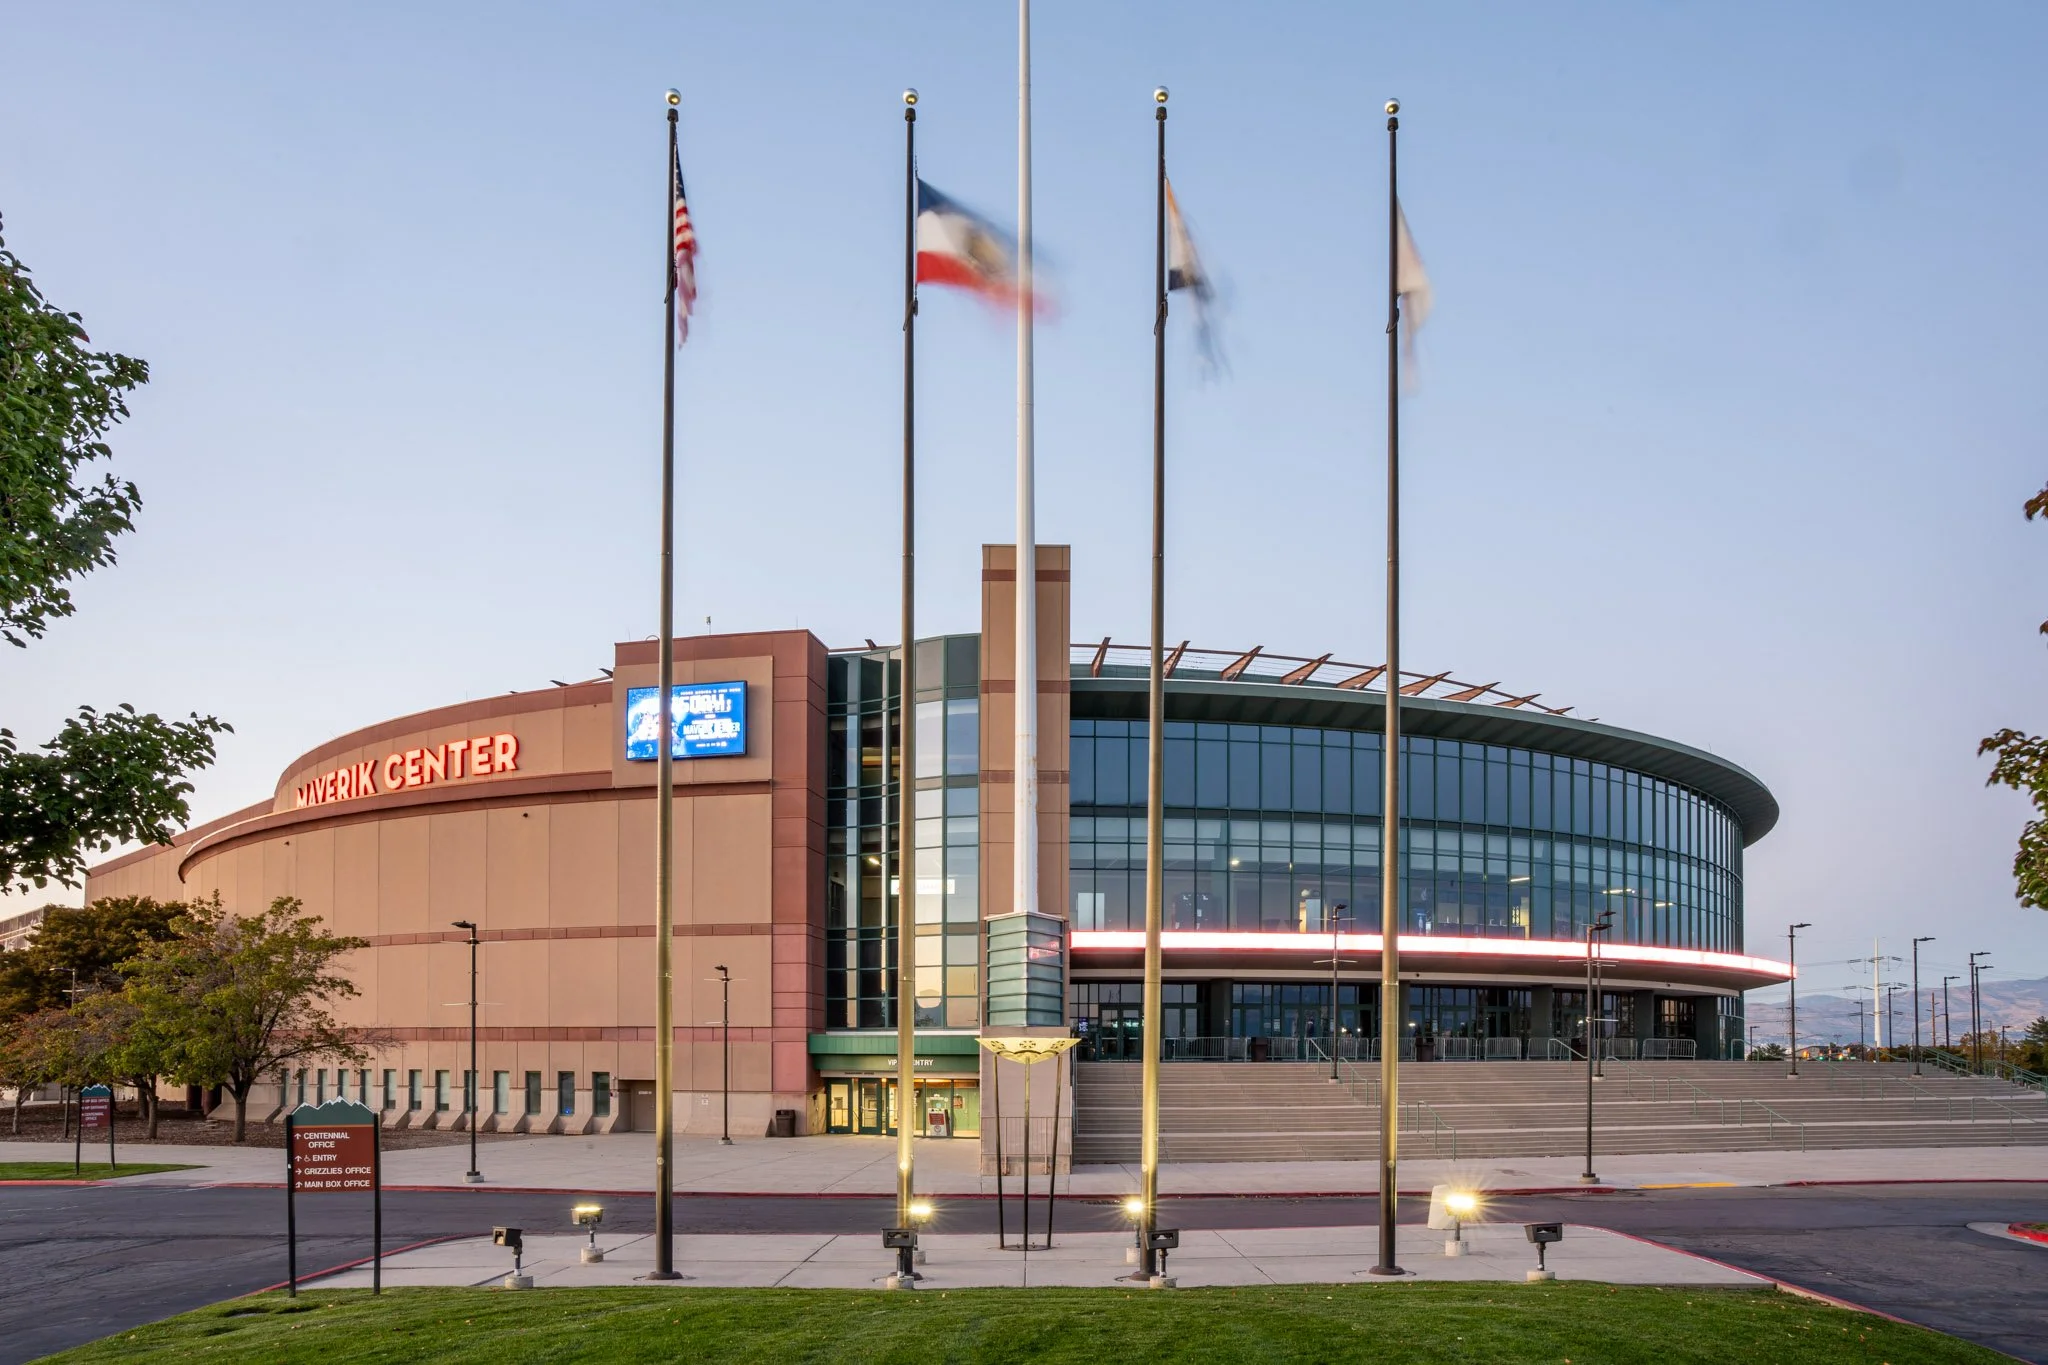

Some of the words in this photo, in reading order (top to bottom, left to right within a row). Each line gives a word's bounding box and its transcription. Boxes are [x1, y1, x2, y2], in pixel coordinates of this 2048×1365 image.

[296, 759, 378, 808] MAVERIK
[383, 733, 519, 790] CENTER
[312, 1154, 337, 1162] ENTRY
[304, 1167, 343, 1175] GRIZZLIES
[345, 1166, 371, 1174] OFFICE
[326, 1180, 341, 1188] BOX
